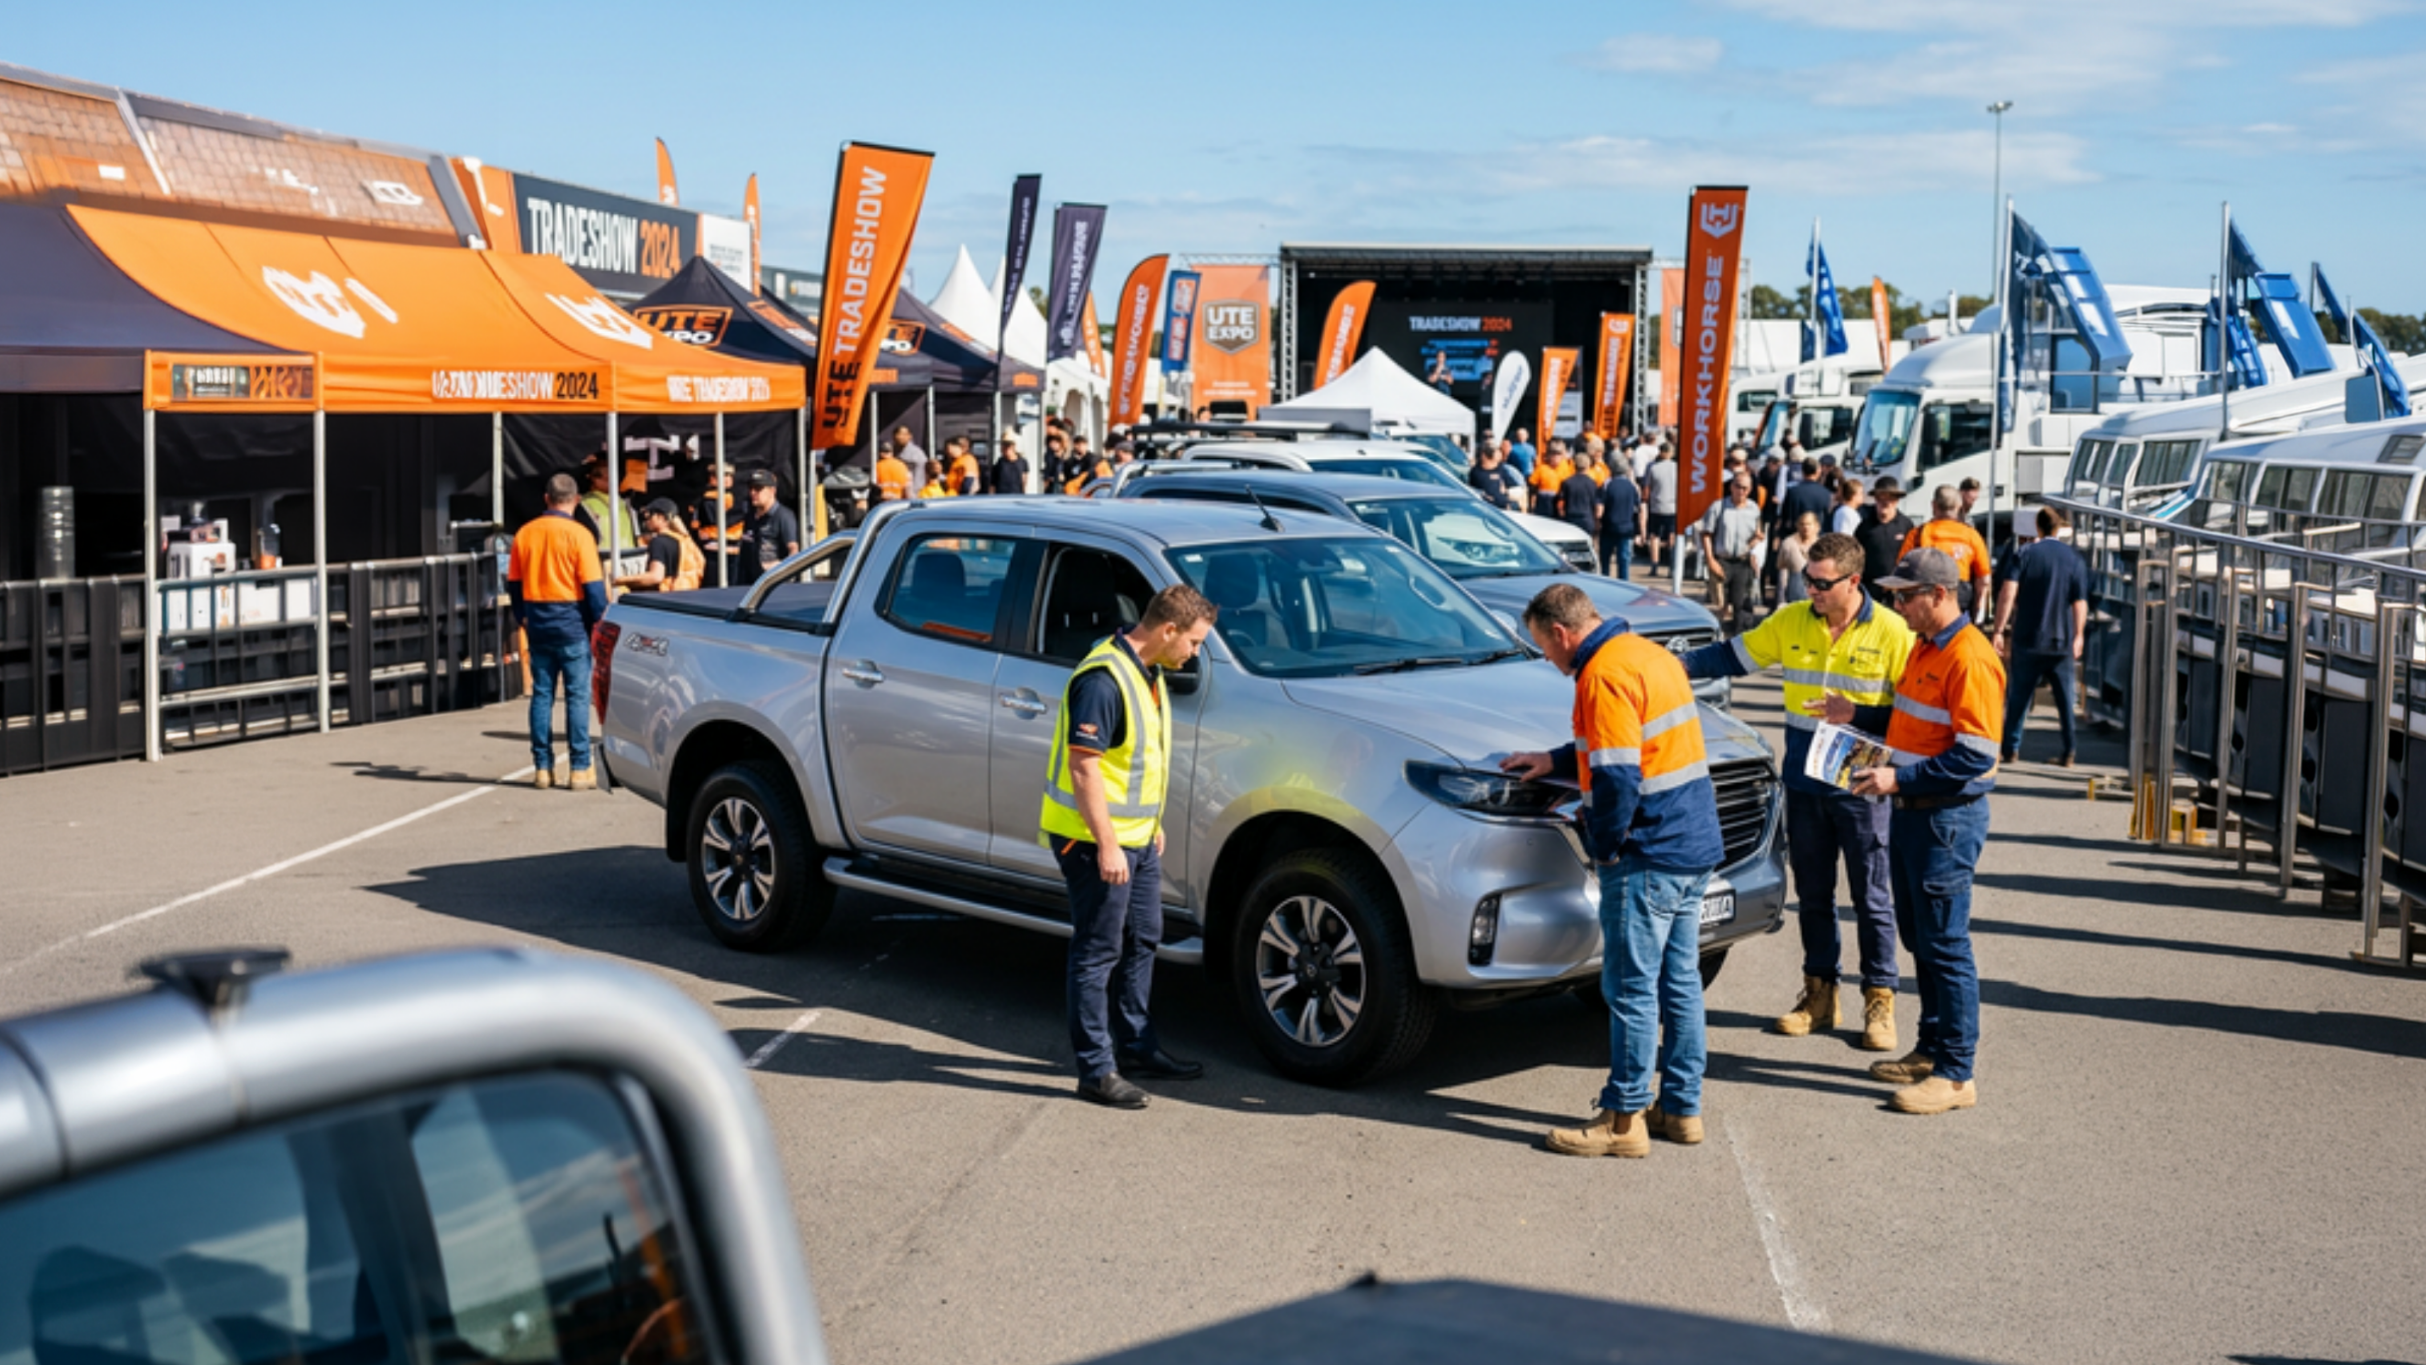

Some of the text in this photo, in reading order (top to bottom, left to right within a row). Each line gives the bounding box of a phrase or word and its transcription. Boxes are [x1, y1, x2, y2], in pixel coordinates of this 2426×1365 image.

[527, 196, 638, 275] TRADESHOW
[640, 218, 682, 279] 2024
[822, 166, 887, 430] UTE TRADESHOW
[641, 311, 722, 331] UTE
[1208, 306, 1254, 325] UTE
[1208, 326, 1254, 341] EXPO
[557, 371, 598, 399] 2024
[1690, 256, 1724, 494] WORKHORSE
